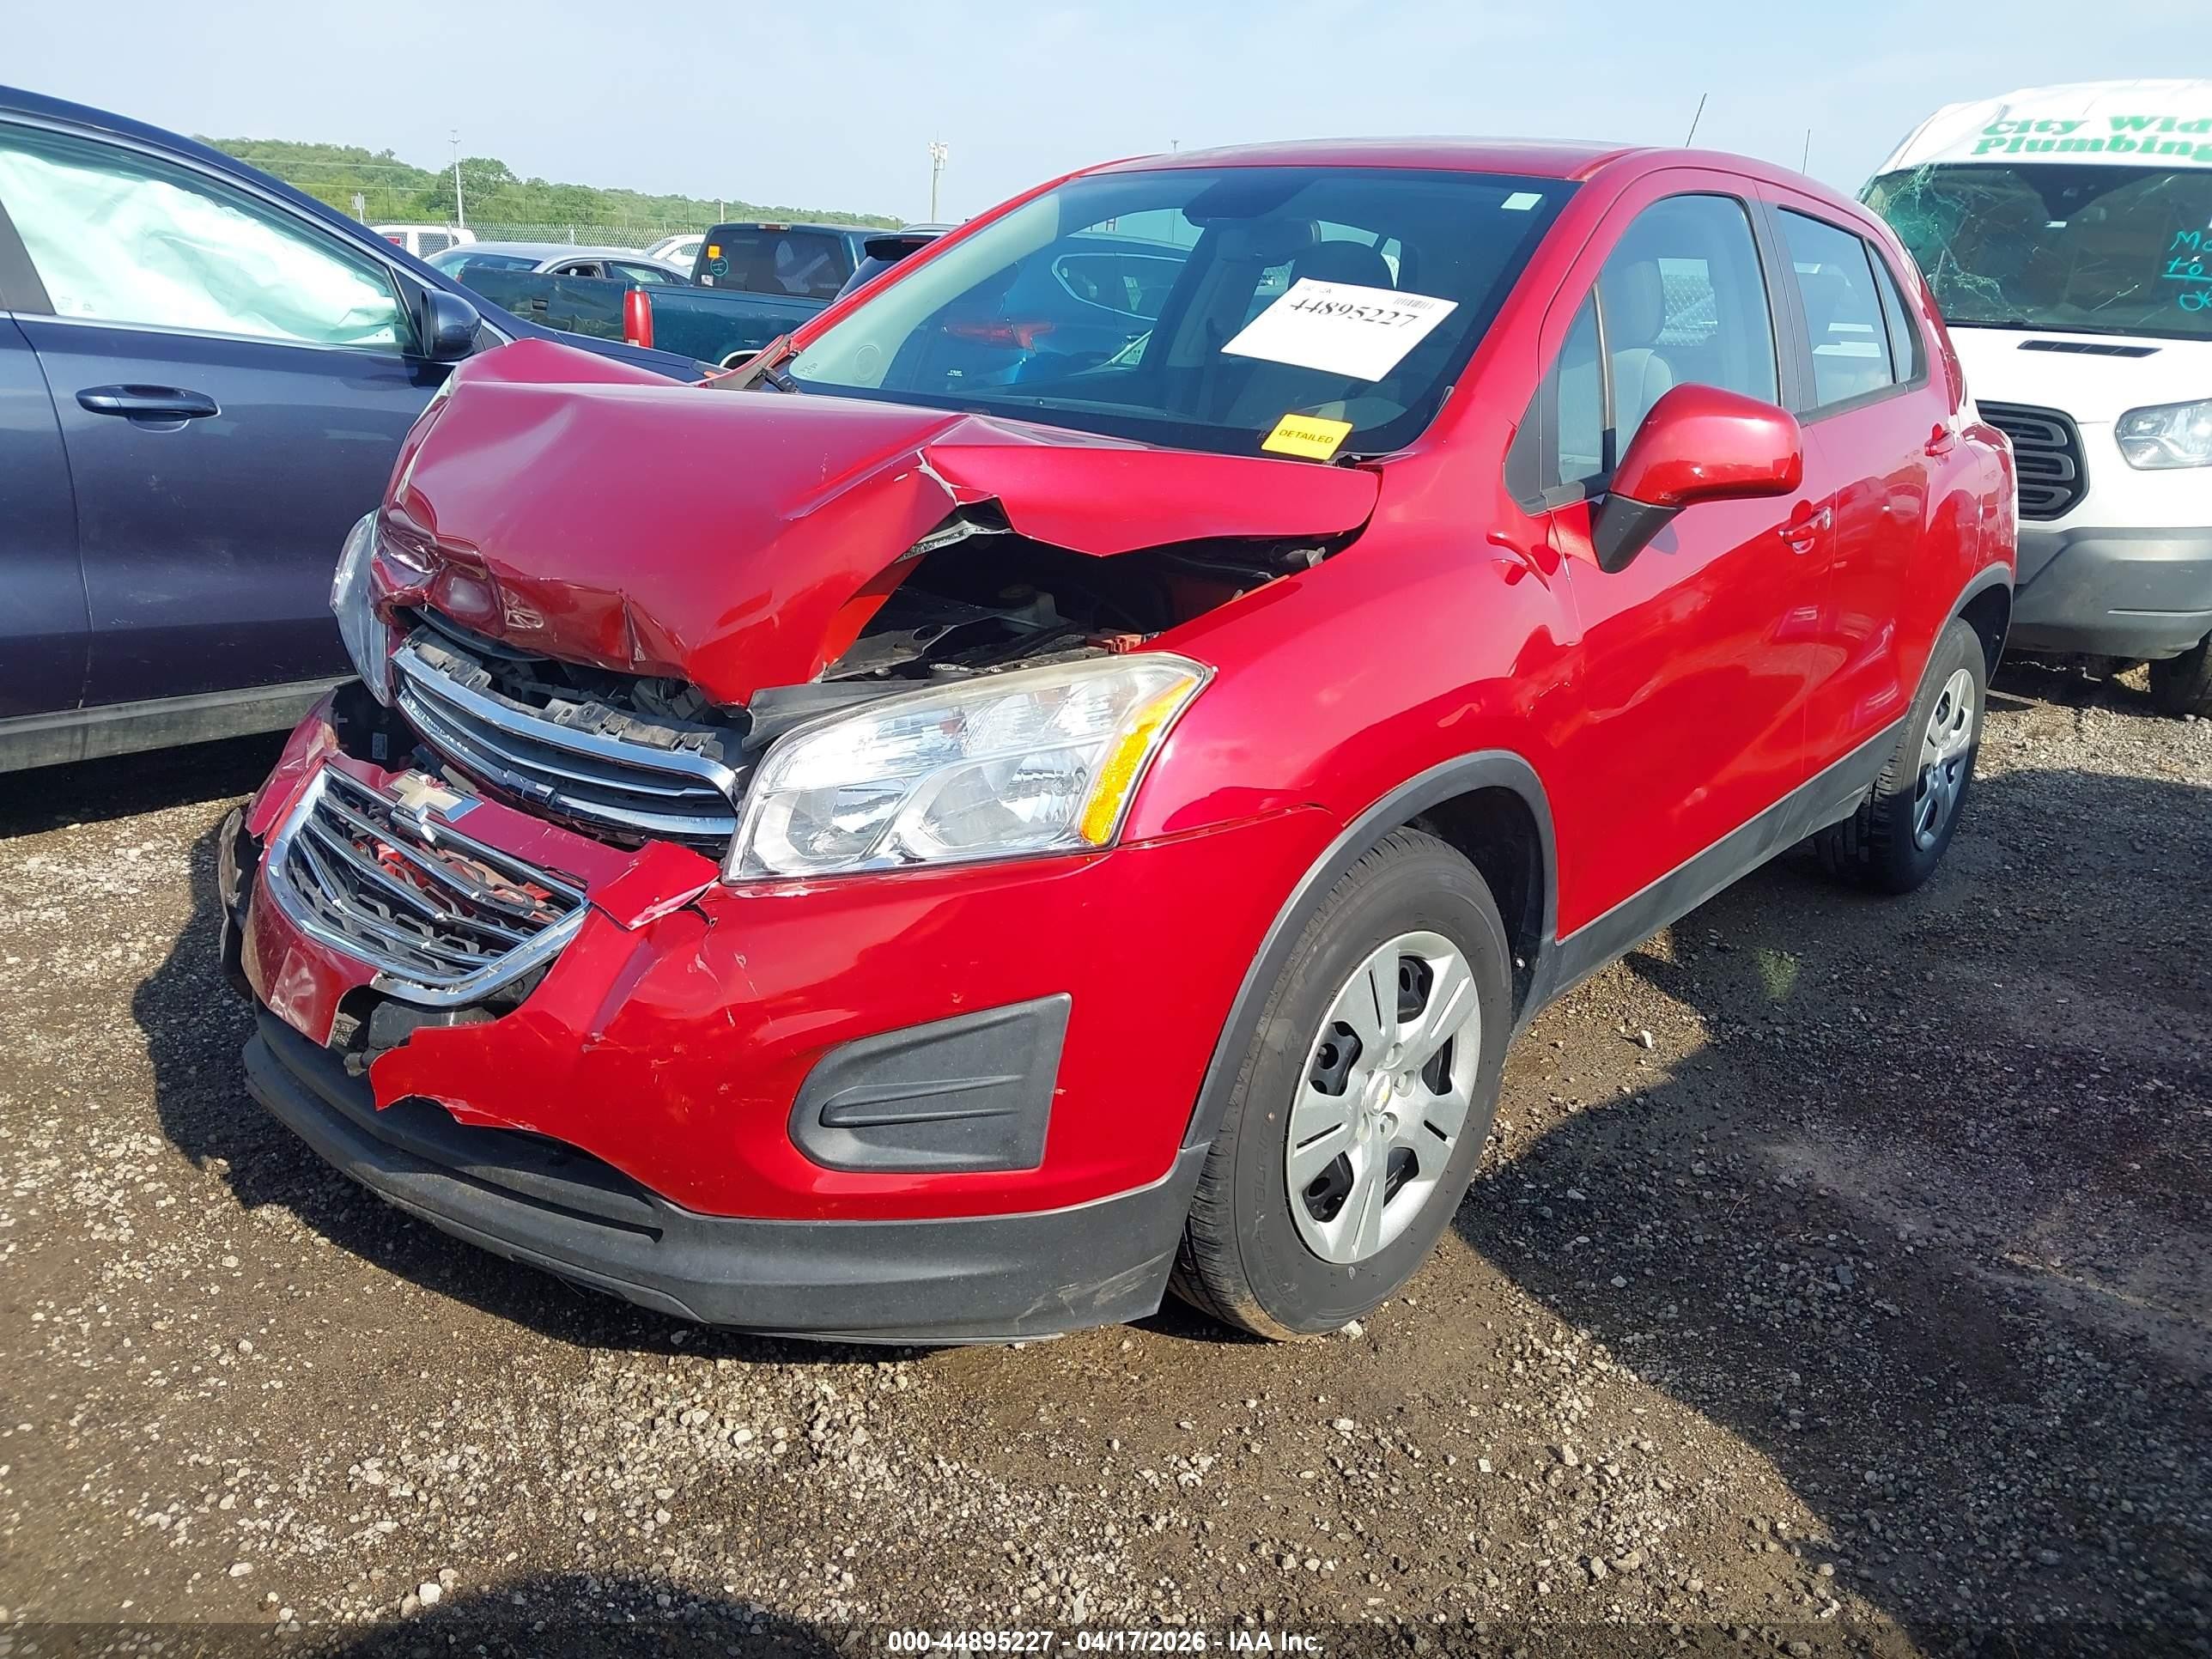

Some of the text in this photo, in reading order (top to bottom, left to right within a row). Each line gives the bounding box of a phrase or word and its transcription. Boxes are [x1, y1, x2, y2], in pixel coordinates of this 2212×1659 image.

[1981, 118, 2089, 135] City
[1971, 135, 2212, 162] Plumbing
[1290, 298, 1419, 328] 44895227
[1279, 428, 1334, 445] DETAILED
